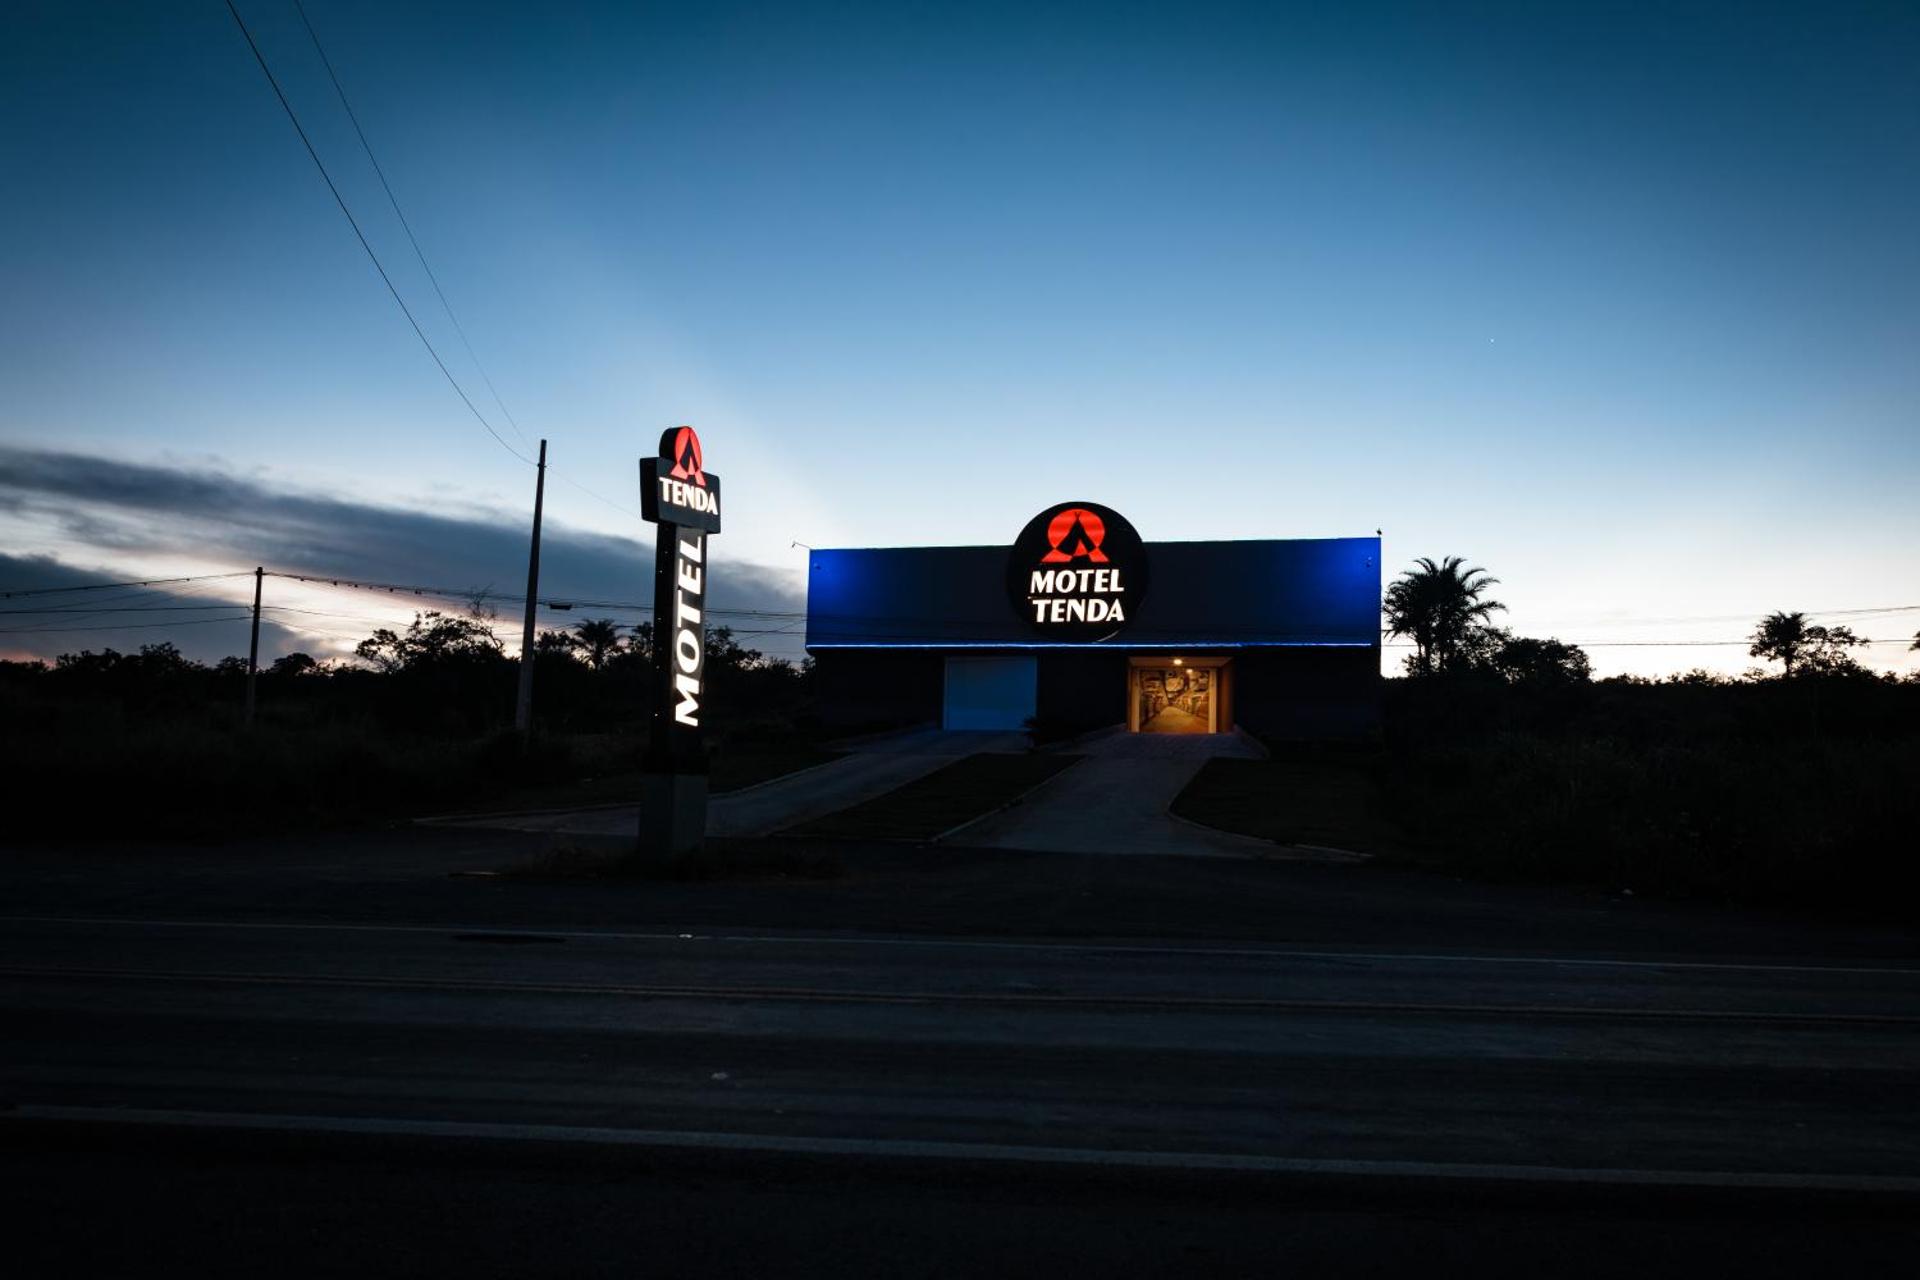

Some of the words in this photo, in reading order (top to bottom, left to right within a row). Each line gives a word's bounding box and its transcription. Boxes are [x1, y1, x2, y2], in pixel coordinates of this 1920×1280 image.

[659, 477, 718, 515] TENDA
[1030, 569, 1124, 593] MOTEL
[1032, 598, 1125, 623] TENDA
[675, 536, 702, 727] MOTEL
